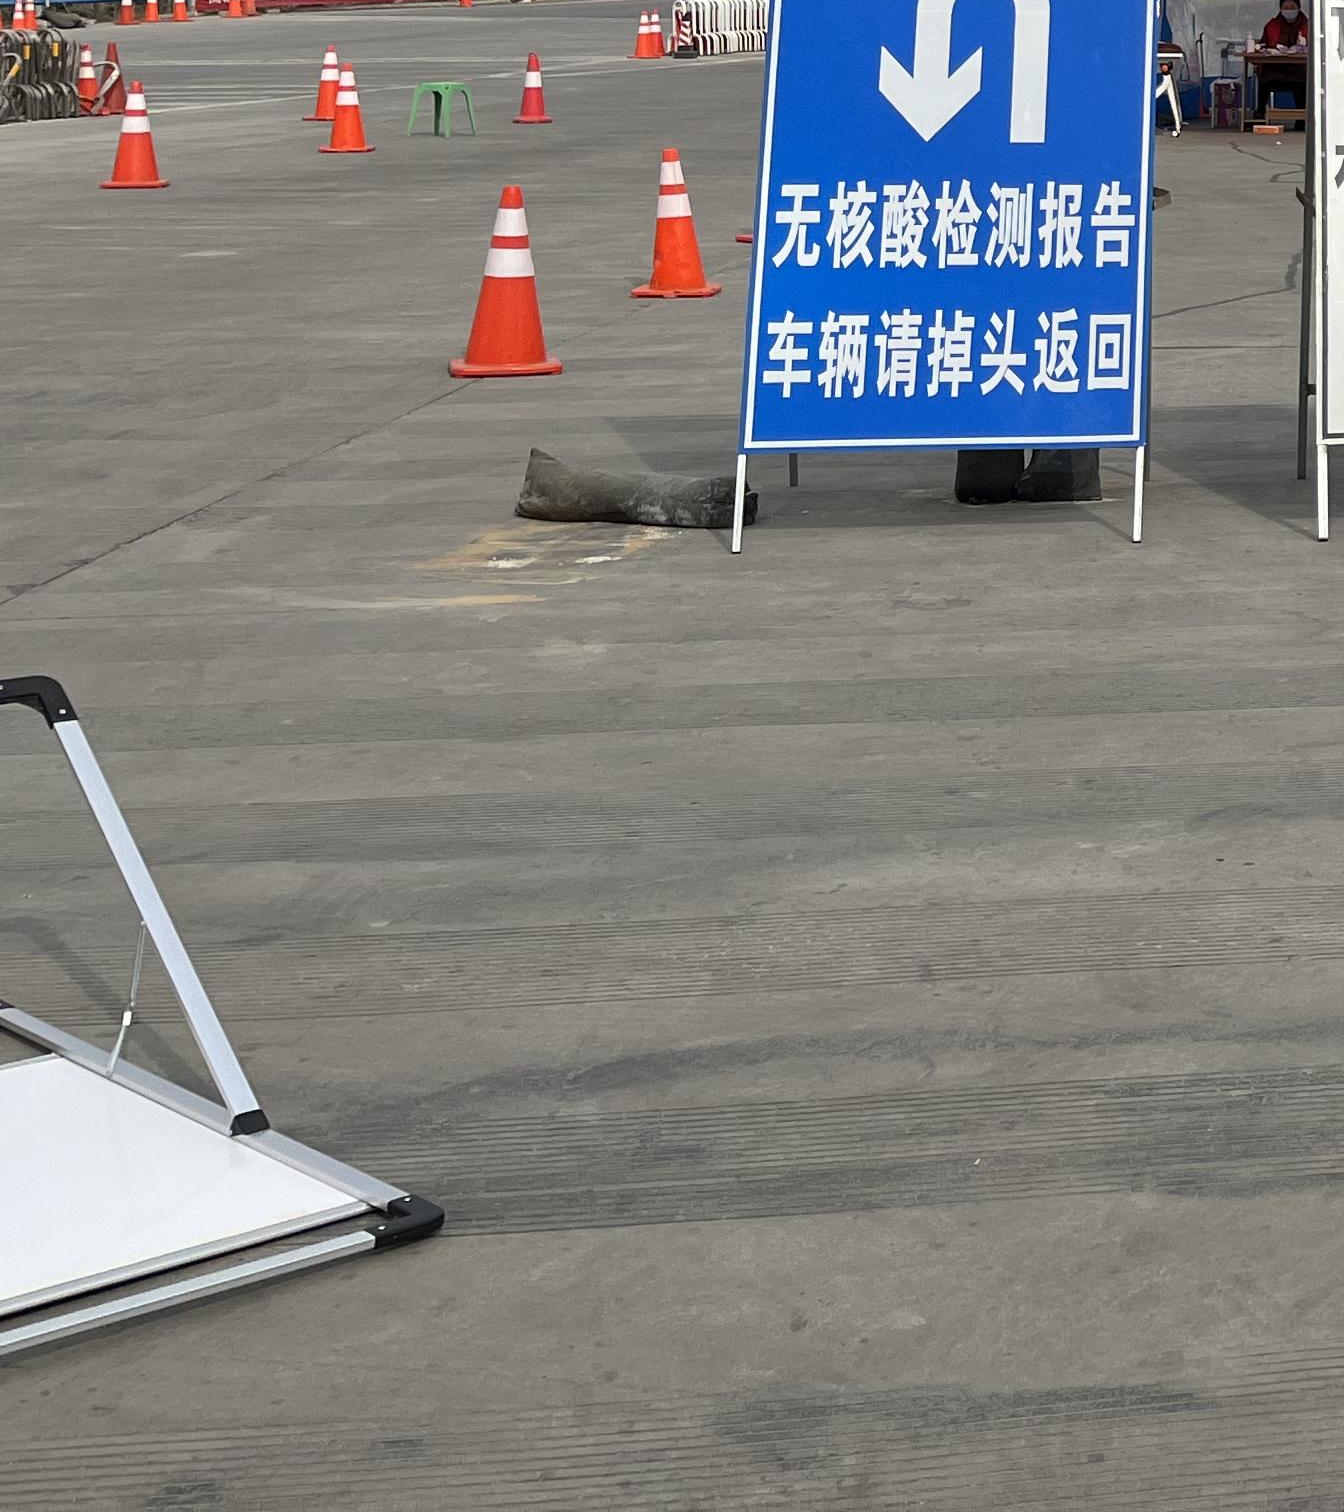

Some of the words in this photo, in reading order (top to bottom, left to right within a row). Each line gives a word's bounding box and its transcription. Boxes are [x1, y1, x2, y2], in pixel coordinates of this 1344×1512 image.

[771, 179, 1136, 269] 无核酸检测报告
[762, 308, 1133, 399] 车辆请掉头返回
